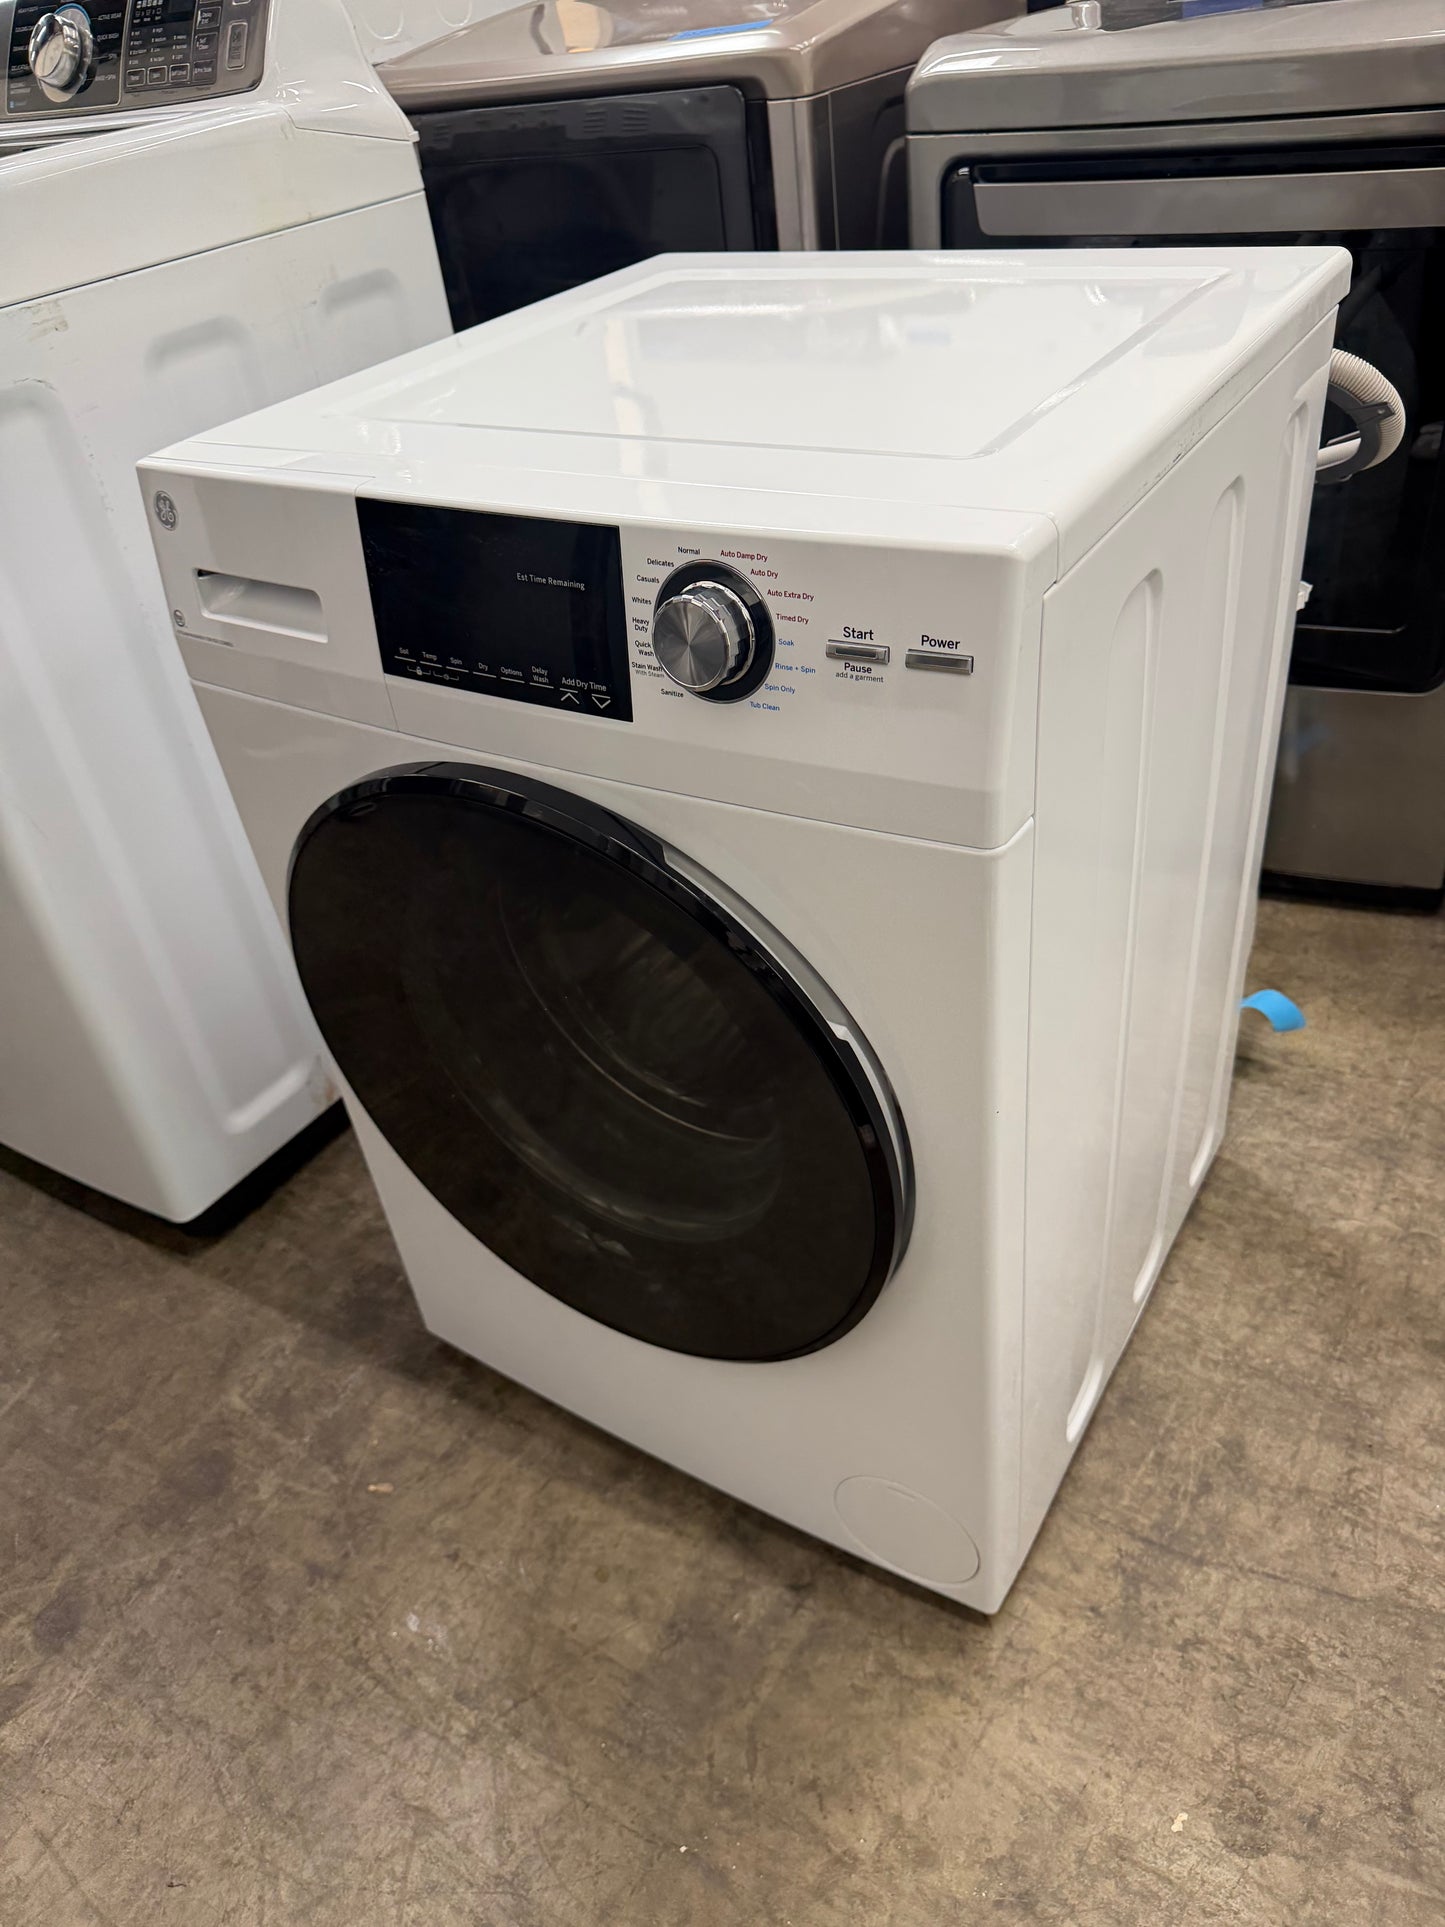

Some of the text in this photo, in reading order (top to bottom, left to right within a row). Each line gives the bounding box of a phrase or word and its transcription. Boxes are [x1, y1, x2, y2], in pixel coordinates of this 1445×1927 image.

[677, 546, 701, 556] Normal
[720, 549, 769, 563] Auto Damp Dry
[646, 557, 675, 568] Delicates
[636, 574, 660, 584] Casuals
[750, 568, 779, 579] Auto Dry
[516, 572, 586, 591] Est Time Remaining
[631, 596, 652, 606] Whites
[767, 589, 815, 602] Auto Extra Dry
[632, 616, 650, 627] Heavy
[775, 613, 809, 625] Timed Dry
[634, 624, 649, 633] Duty
[842, 626, 874, 641] Start
[634, 640, 651, 649] Quick
[778, 638, 795, 647] Soak
[920, 634, 961, 650] Power
[422, 651, 438, 662] Temp
[638, 649, 654, 657] Wash
[450, 656, 463, 665] Spin
[478, 662, 489, 672] Dry
[500, 666, 523, 677] Options
[531, 665, 549, 676] Delay
[631, 661, 663, 672] Stain Wash
[774, 662, 794, 672] Rinse
[800, 665, 816, 674] Spin
[844, 662, 873, 674] Pause
[532, 674, 549, 684] Wash
[835, 671, 848, 679] add
[854, 674, 884, 683] garment
[561, 676, 607, 692] Add Dry Time
[764, 683, 796, 694] Spin Only
[660, 688, 684, 698] Sanitize
[749, 701, 780, 711] Tub Clean
